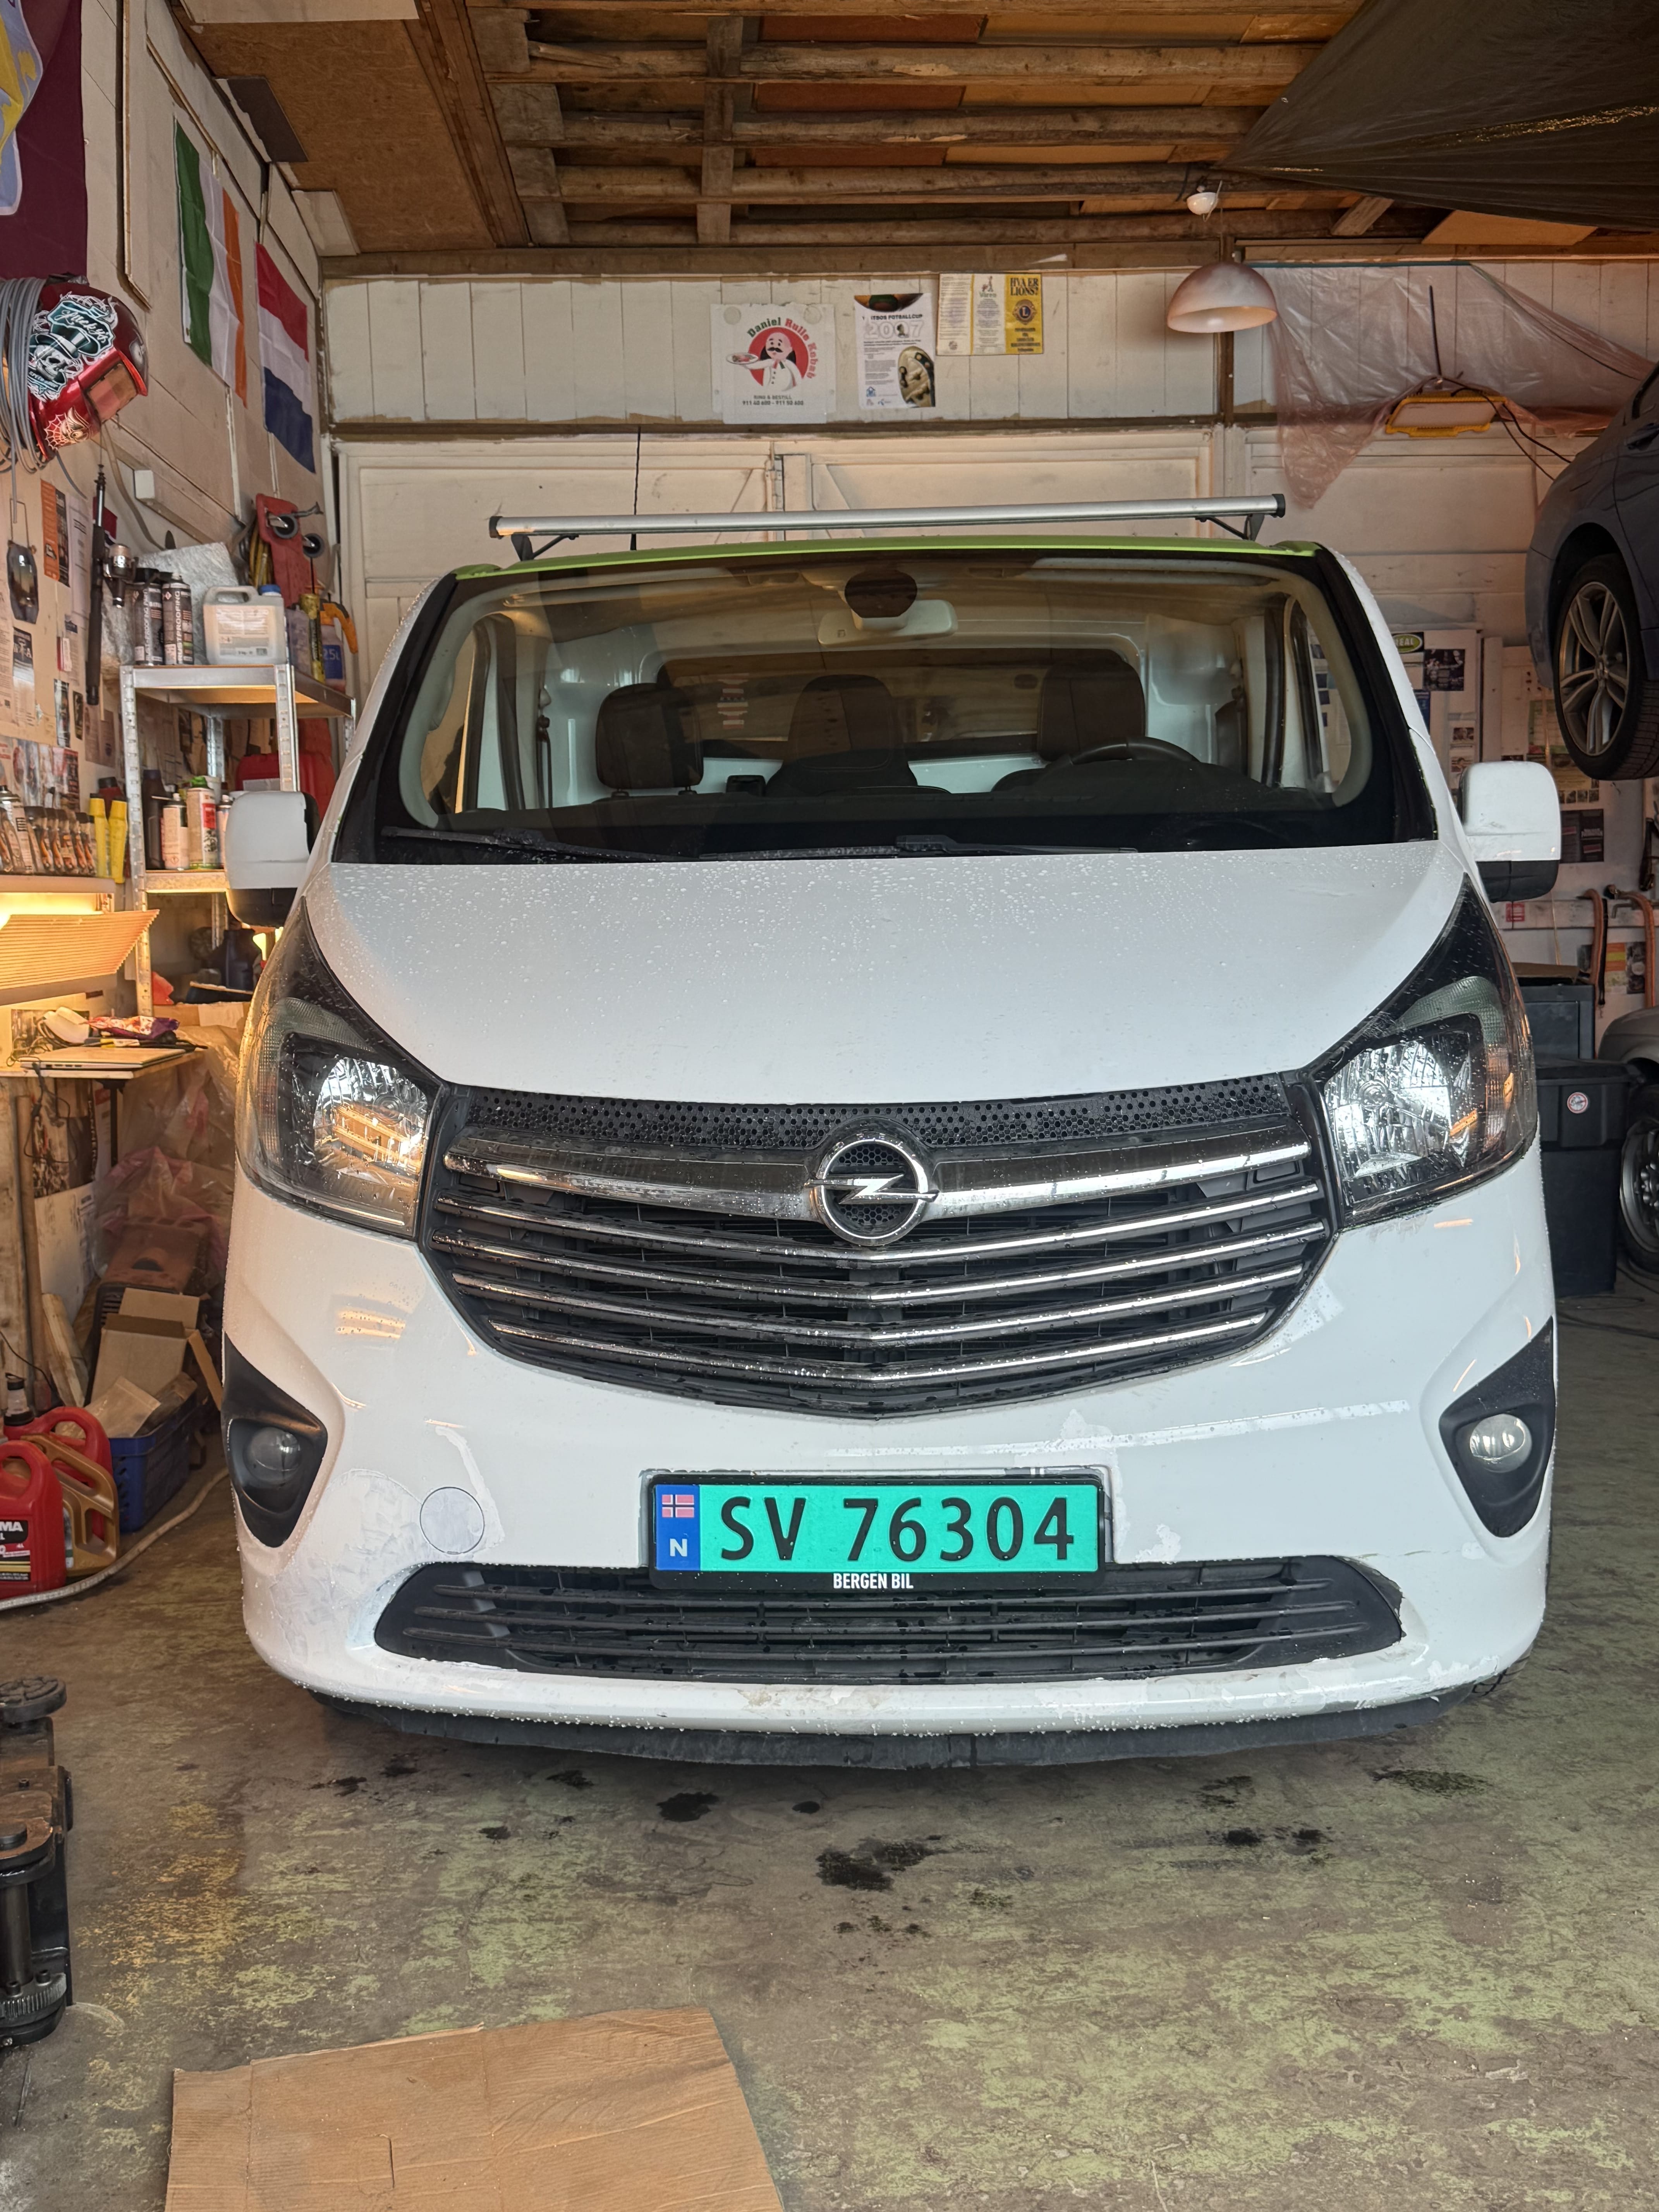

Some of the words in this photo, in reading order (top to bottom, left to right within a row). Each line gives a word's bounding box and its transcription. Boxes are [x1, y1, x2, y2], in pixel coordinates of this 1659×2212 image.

[1010, 278, 1027, 287] HVA
[1028, 278, 1039, 287] ER
[54, 310, 109, 343] Lucky's
[747, 317, 781, 338] Daniel
[175, 591, 183, 661] RUSTPROOFING
[721, 1497, 806, 1560] SV
[844, 1498, 1073, 1561] 76304
[670, 1539, 687, 1556] N
[833, 1573, 887, 1589] BERGEN
[892, 1573, 914, 1589] BIL
